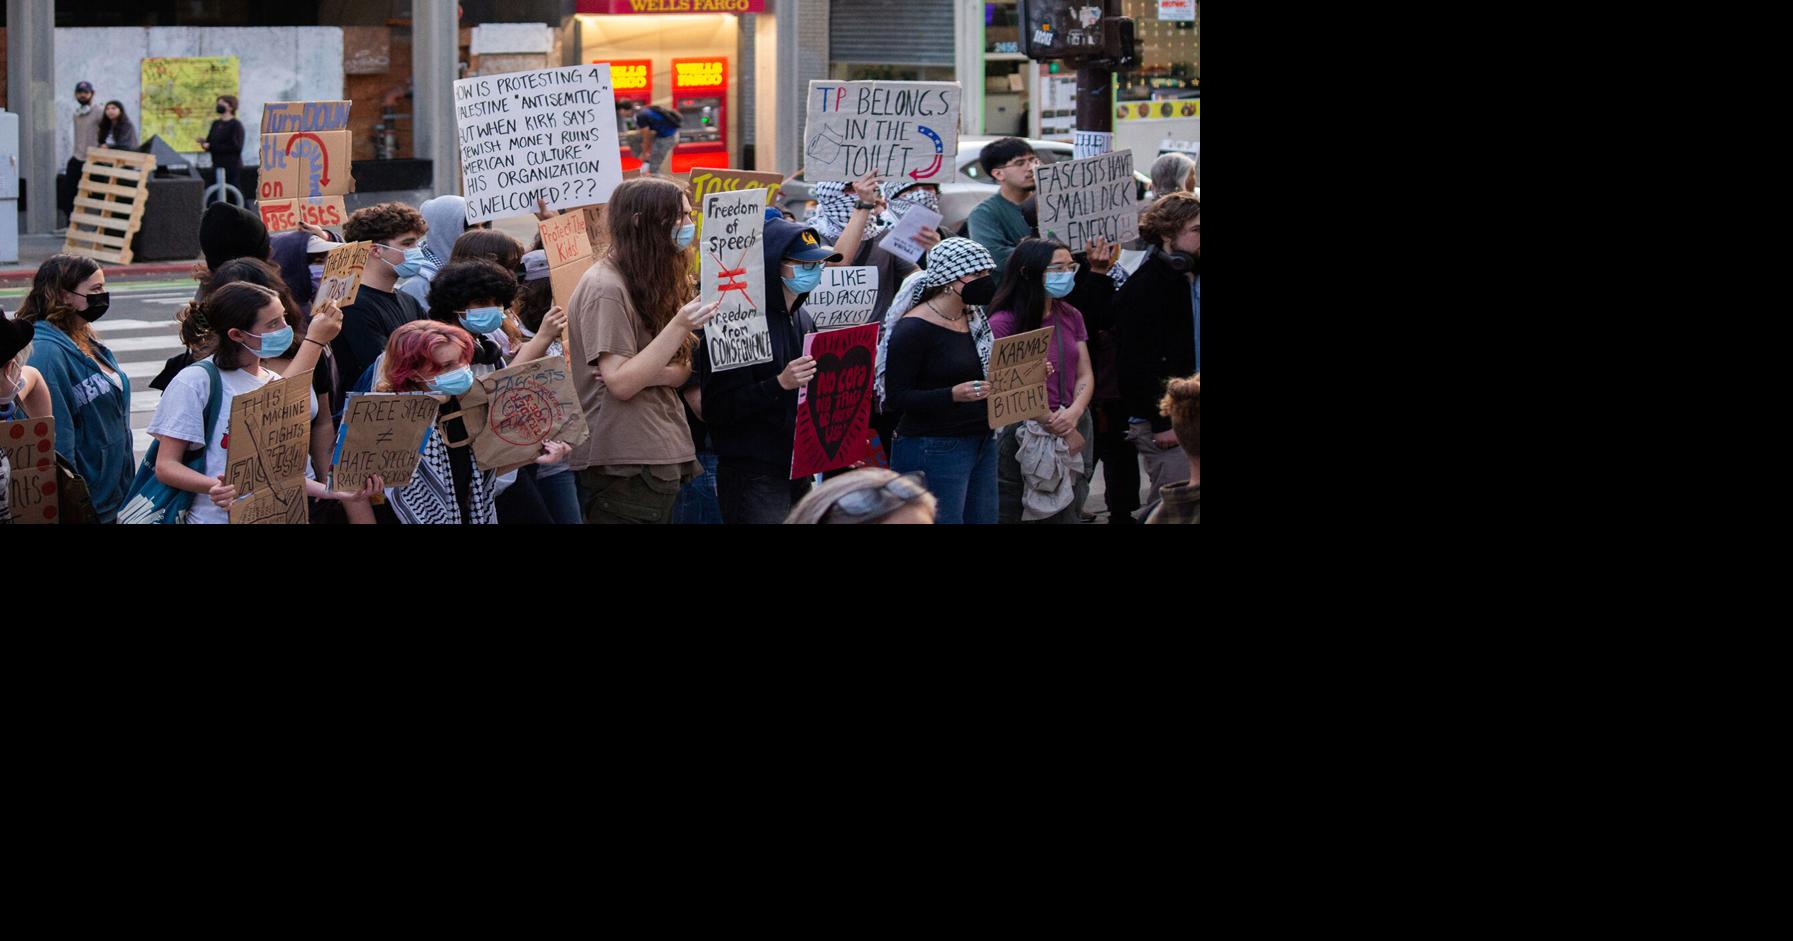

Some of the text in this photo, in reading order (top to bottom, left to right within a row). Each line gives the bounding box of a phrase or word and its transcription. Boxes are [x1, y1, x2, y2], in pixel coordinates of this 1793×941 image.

[631, 0, 749, 11] WELLS FARGO
[610, 65, 647, 77] ELLS
[456, 68, 599, 101] OW IS PROTESTING A
[458, 98, 510, 119] ALESTINE
[816, 87, 950, 116] TP BELONGS
[265, 104, 302, 132] Turn
[477, 119, 517, 138] WHEN
[525, 113, 557, 131] KIRK
[563, 109, 595, 126] SAYS
[846, 119, 913, 141] IN THE
[509, 133, 552, 150] MONEY
[561, 127, 599, 144] RUINS
[840, 144, 914, 178] TOILET
[467, 160, 599, 194] HIS ORGANIZATION
[1037, 153, 1133, 195] FASCISTS HAVE
[262, 181, 283, 198] on
[467, 200, 477, 221] IS
[708, 197, 758, 219] Freedom
[1044, 181, 1131, 223] SMALL DICK
[261, 200, 341, 232] Fascists
[726, 219, 739, 234] of
[1068, 214, 1121, 252] ENERGY
[832, 269, 866, 287] LIKE
[836, 289, 879, 306] FASCIST
[829, 309, 871, 325] FASCIST
[722, 325, 748, 341] from
[242, 389, 281, 416] THIS
[262, 400, 305, 426] MACHINE
[351, 400, 401, 424] FREE
[994, 385, 1045, 418] BITCH!
[268, 423, 304, 447] FIGHTS
[339, 449, 377, 473] HATE
[337, 471, 376, 490] RACIS
